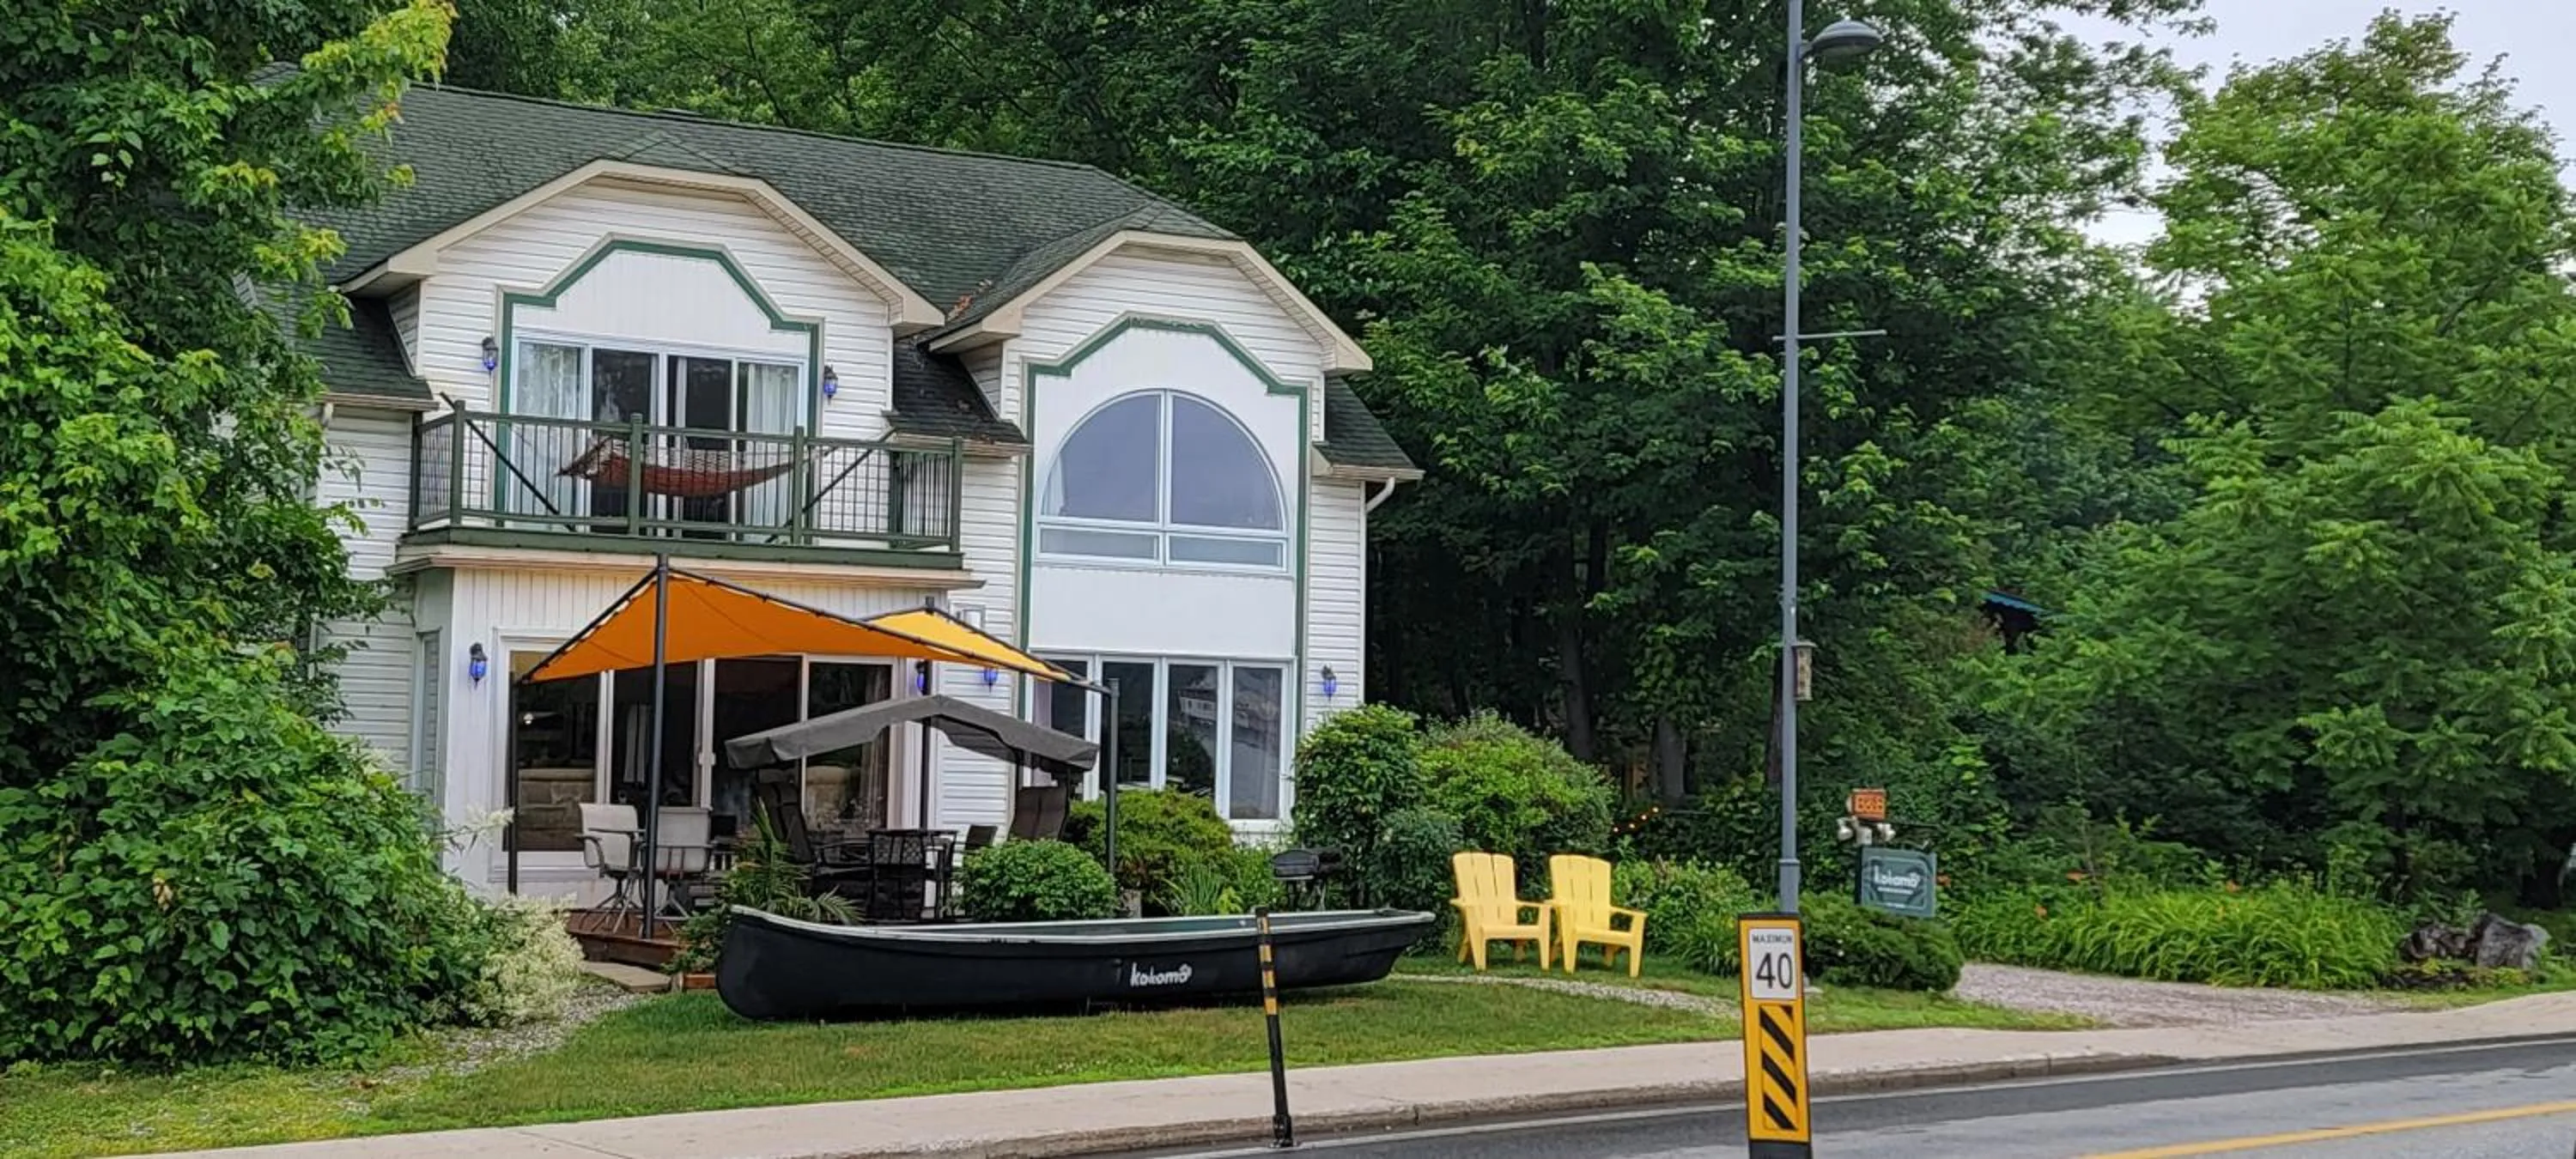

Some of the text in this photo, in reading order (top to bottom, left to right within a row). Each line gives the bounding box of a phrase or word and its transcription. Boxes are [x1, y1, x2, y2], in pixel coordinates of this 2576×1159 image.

[1753, 933, 1792, 944] MAXIMUM
[1130, 962, 1192, 986] kokomo
[1756, 952, 1792, 989] 40
